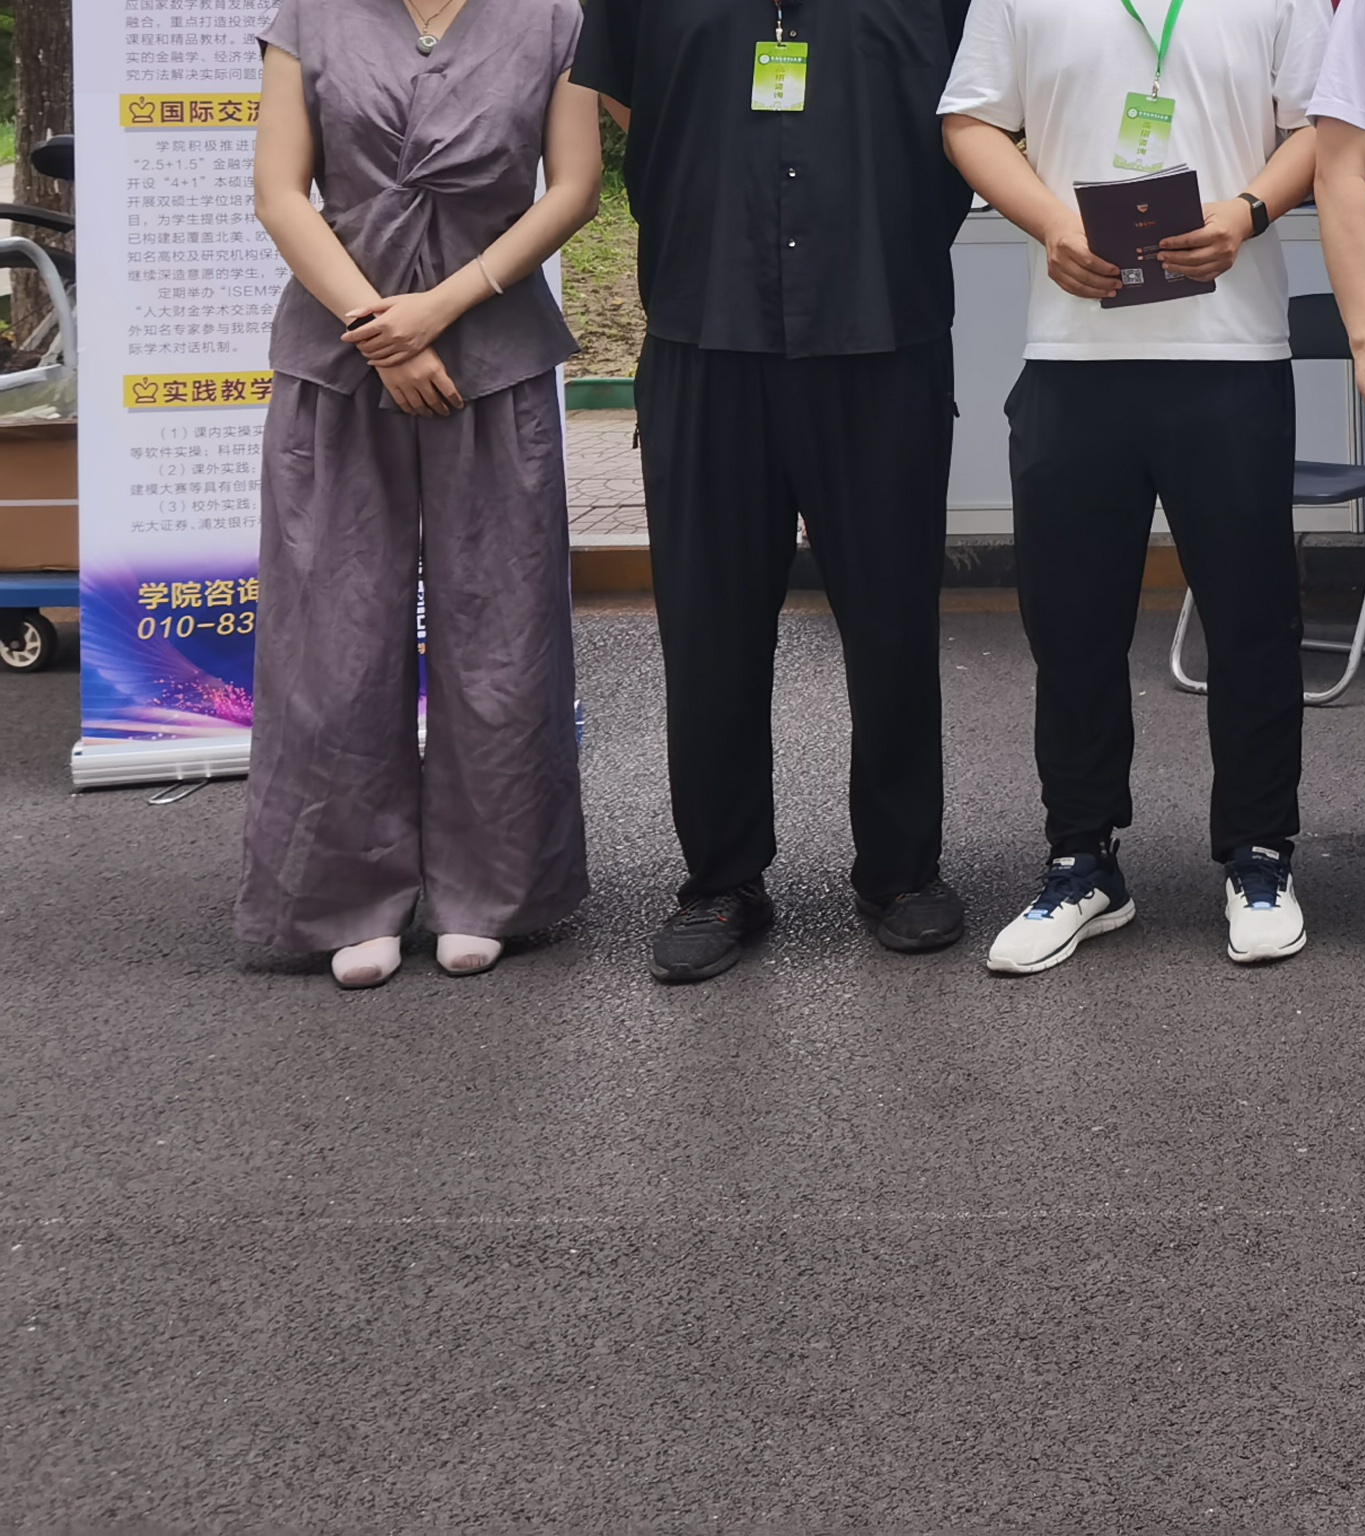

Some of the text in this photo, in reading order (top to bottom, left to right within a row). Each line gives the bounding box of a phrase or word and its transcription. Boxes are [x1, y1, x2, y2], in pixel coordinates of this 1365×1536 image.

[126, 51, 263, 63] 实的金融学、经济学
[128, 230, 274, 244] 已构建起覆盖北美、欧
[163, 378, 272, 402] 实践教学
[130, 515, 261, 533] 光大证券、浦发银行
